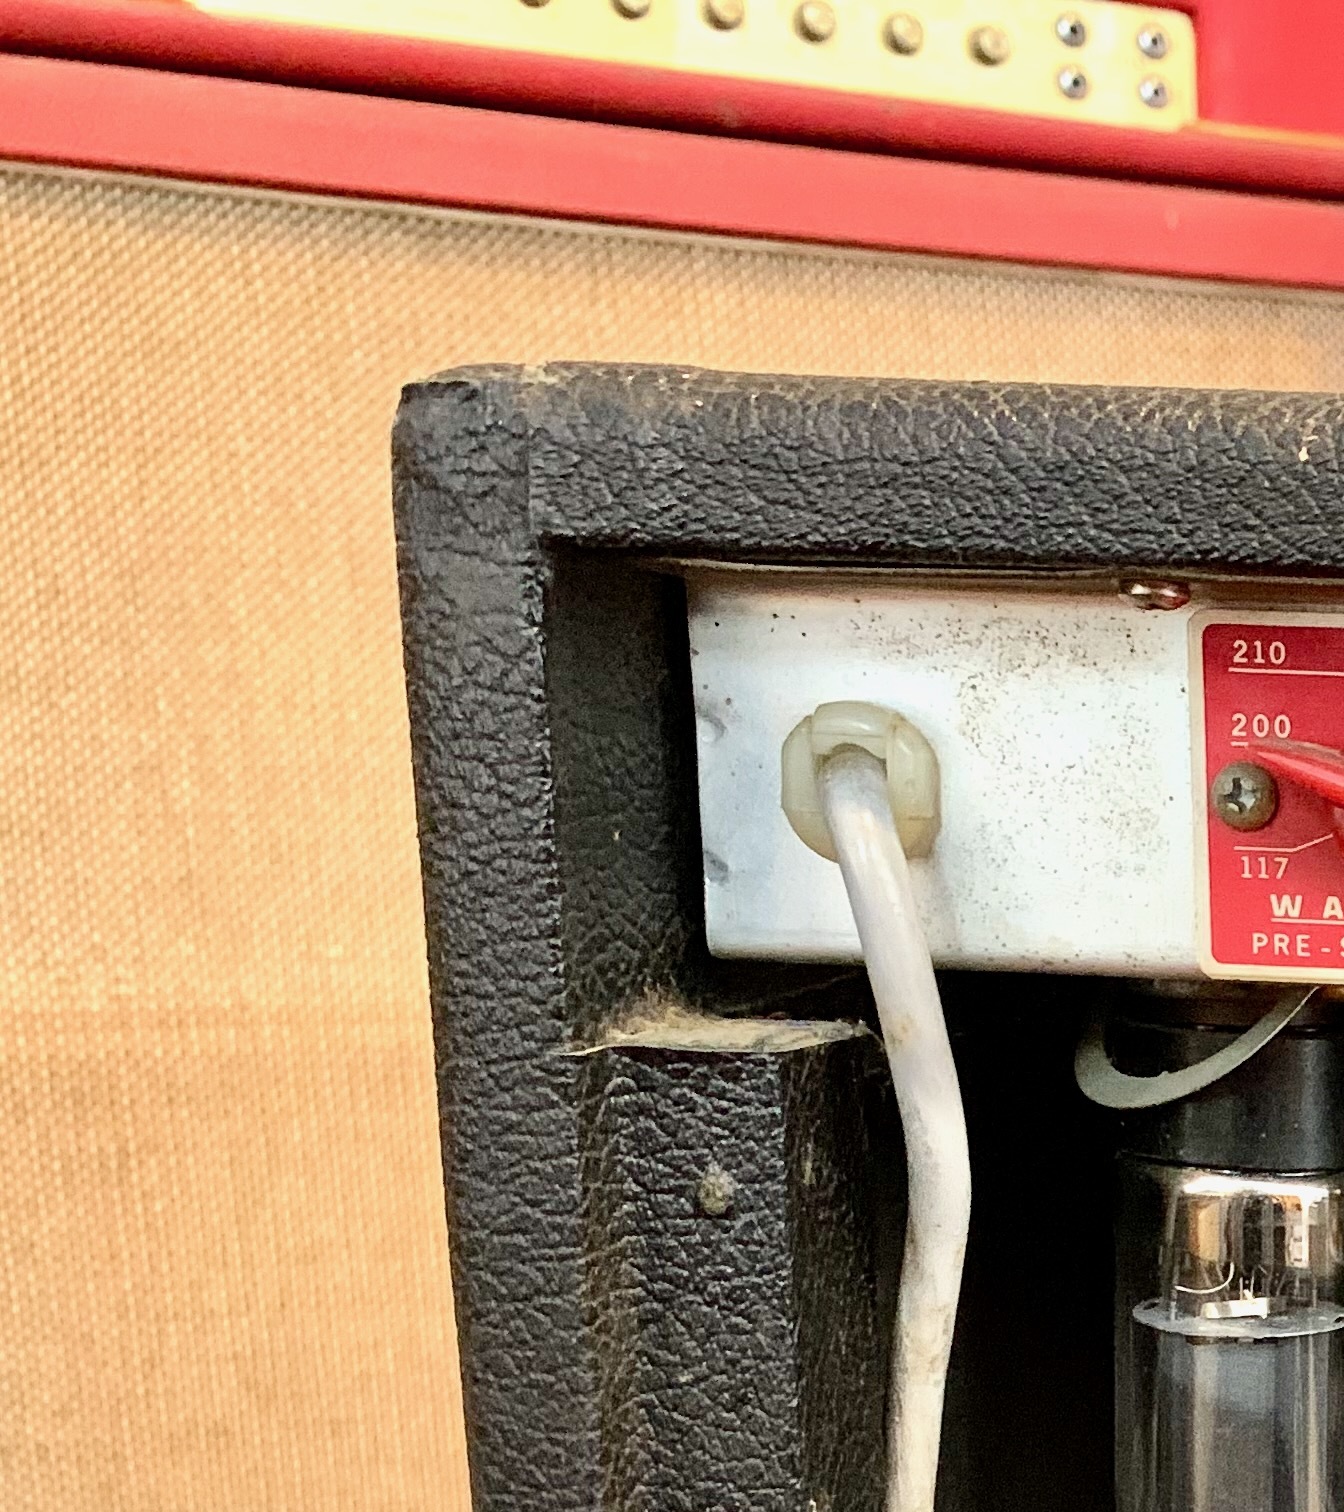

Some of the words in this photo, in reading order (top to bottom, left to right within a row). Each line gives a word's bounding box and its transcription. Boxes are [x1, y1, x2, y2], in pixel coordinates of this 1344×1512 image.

[1233, 640, 1285, 664] 210
[1232, 713, 1290, 738] 200
[1241, 856, 1288, 879] 117
